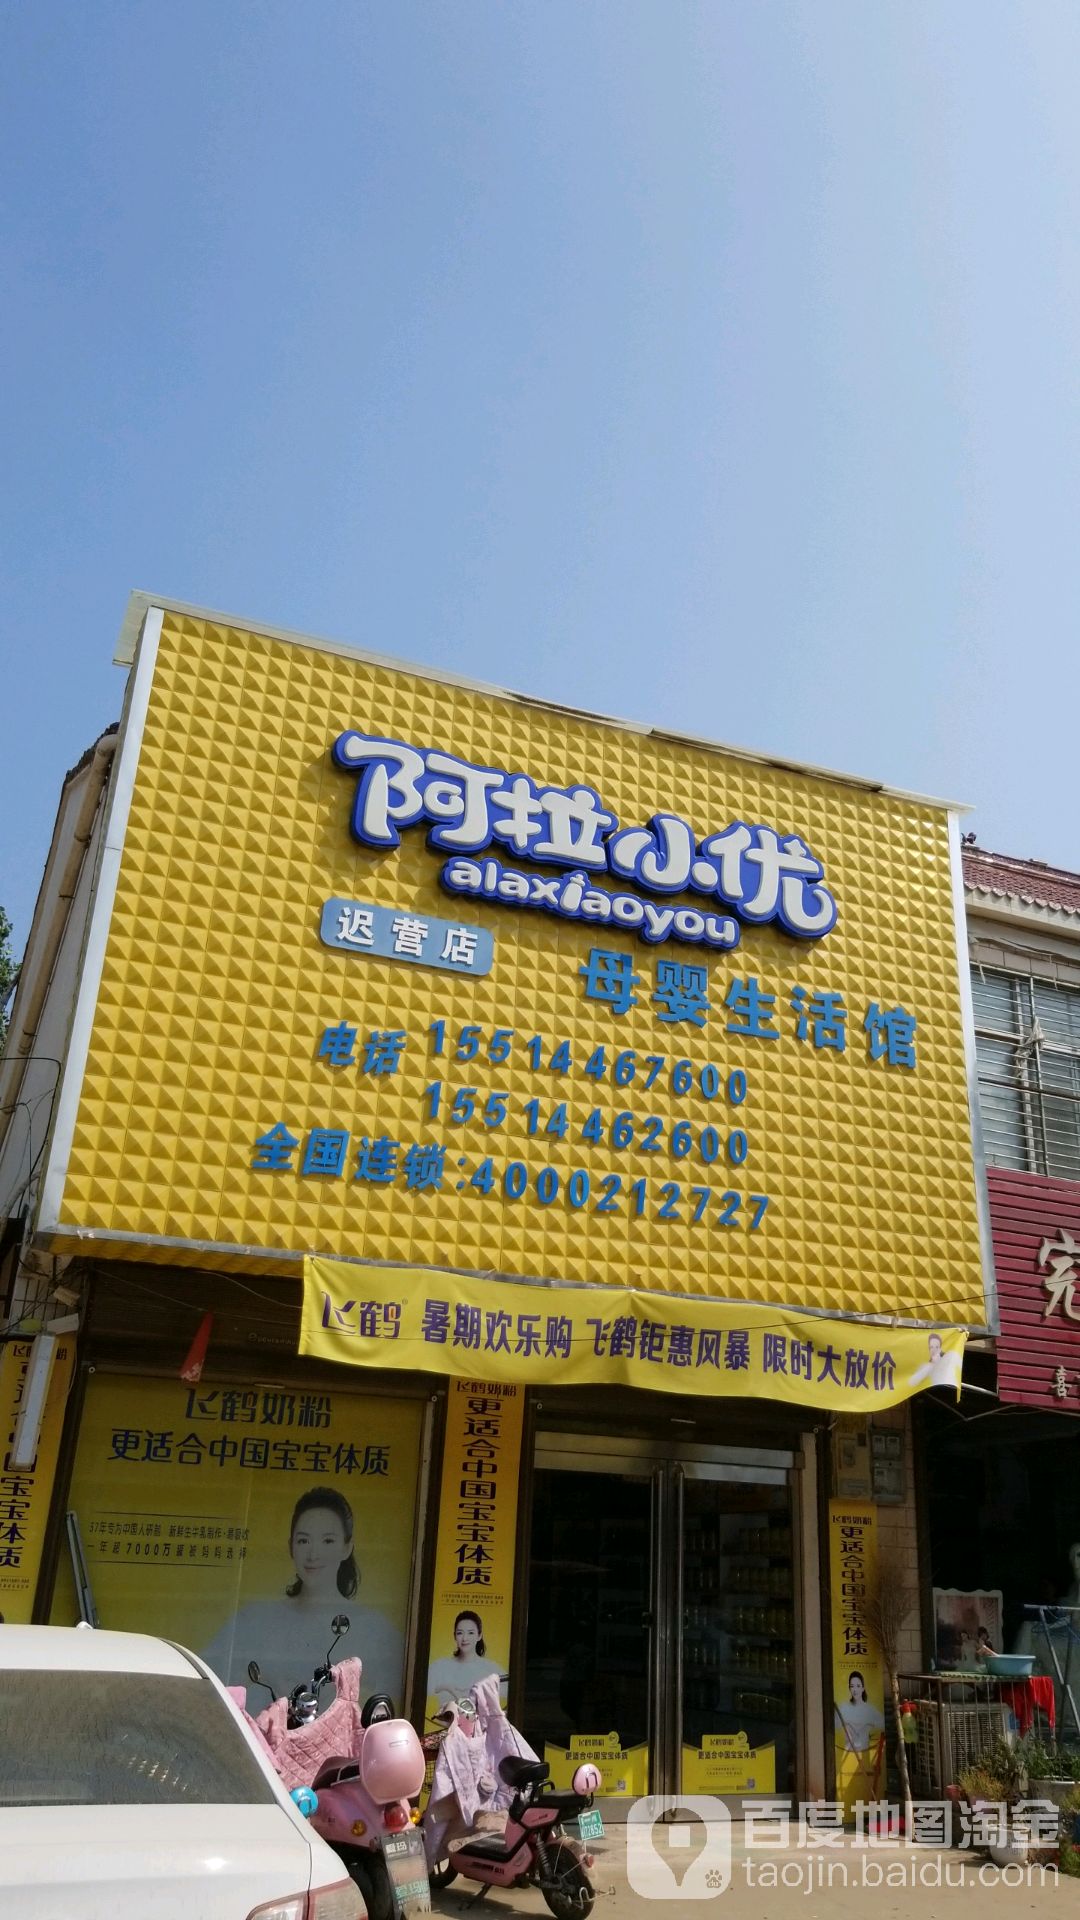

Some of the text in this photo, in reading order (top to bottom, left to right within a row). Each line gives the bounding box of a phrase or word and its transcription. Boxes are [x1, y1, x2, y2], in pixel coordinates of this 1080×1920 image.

[342, 732, 836, 935] 阿拉小优
[337, 906, 478, 965] 迟营店
[448, 860, 737, 943] alaxiaoyou
[579, 948, 918, 1069] 母婴生活馆
[317, 1019, 749, 1105] 电话 15514467600
[423, 1080, 749, 1166] 15514462600
[321, 1290, 897, 1391] 飞鹤 暑期欢乐购 飞鹤钜惠风暴 限时大放价
[185, 1388, 332, 1429] 飞鹤奶粉
[107, 1428, 391, 1476] 更适合中国宝宝体质
[453, 1397, 504, 1586] 更适合中国宝宝体质
[840, 1525, 869, 1656] 更适合中国宝宝体质
